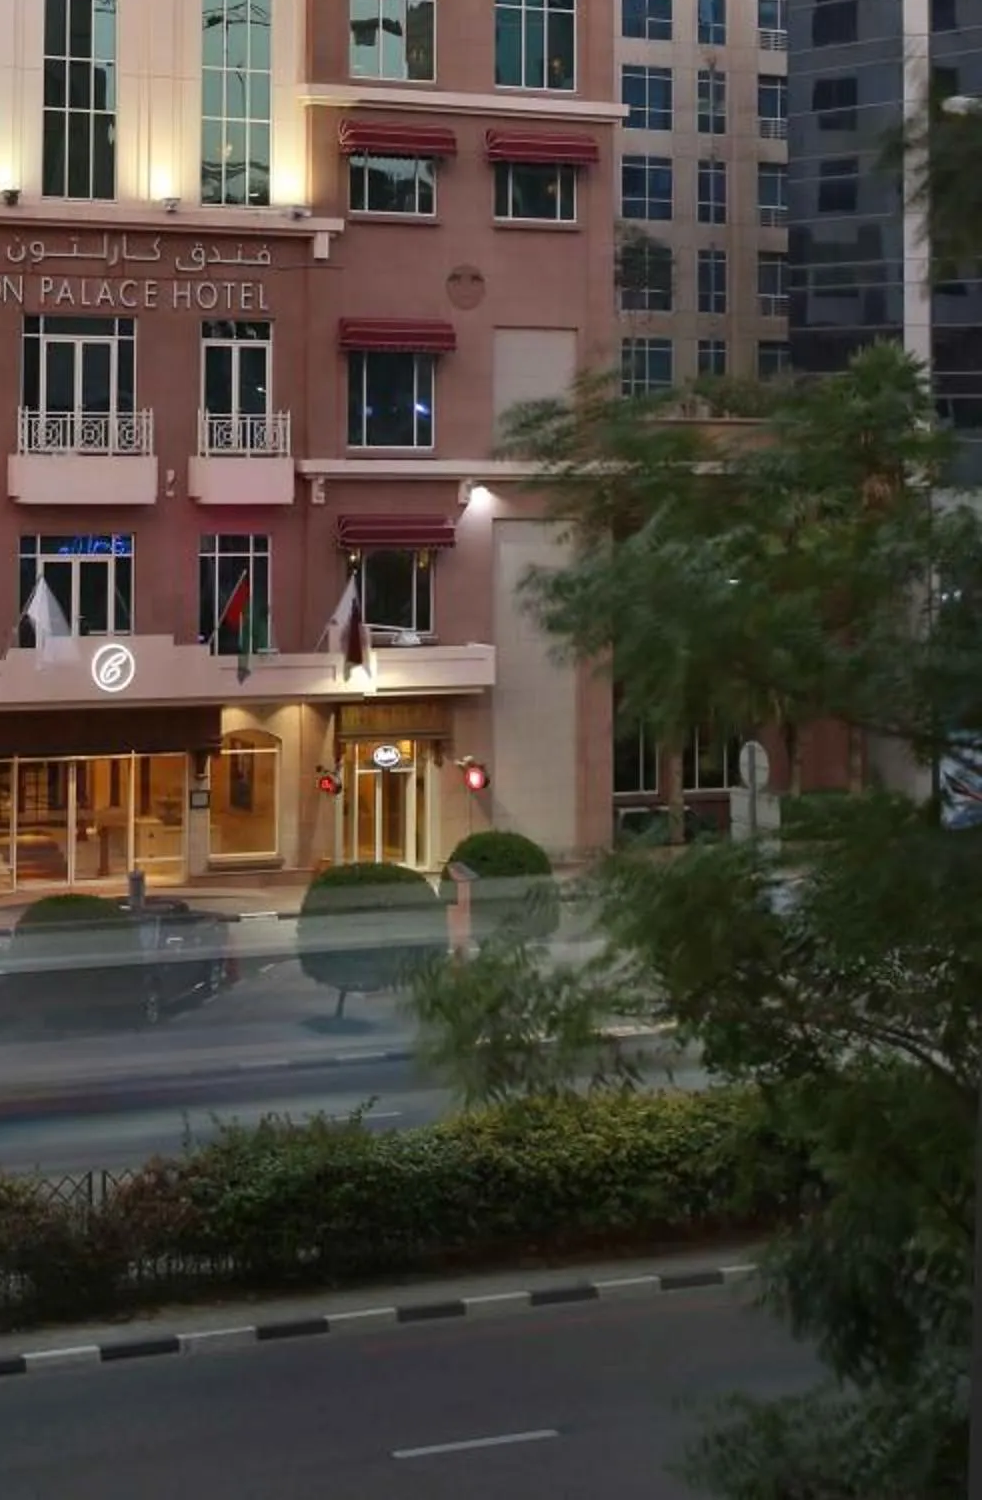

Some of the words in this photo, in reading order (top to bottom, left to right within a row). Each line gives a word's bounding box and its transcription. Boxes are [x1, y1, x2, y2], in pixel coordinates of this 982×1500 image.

[7, 231, 161, 266] كارلتون
[175, 242, 271, 271] فندق
[40, 276, 159, 308] PALACE
[173, 280, 269, 310] HOTEL
